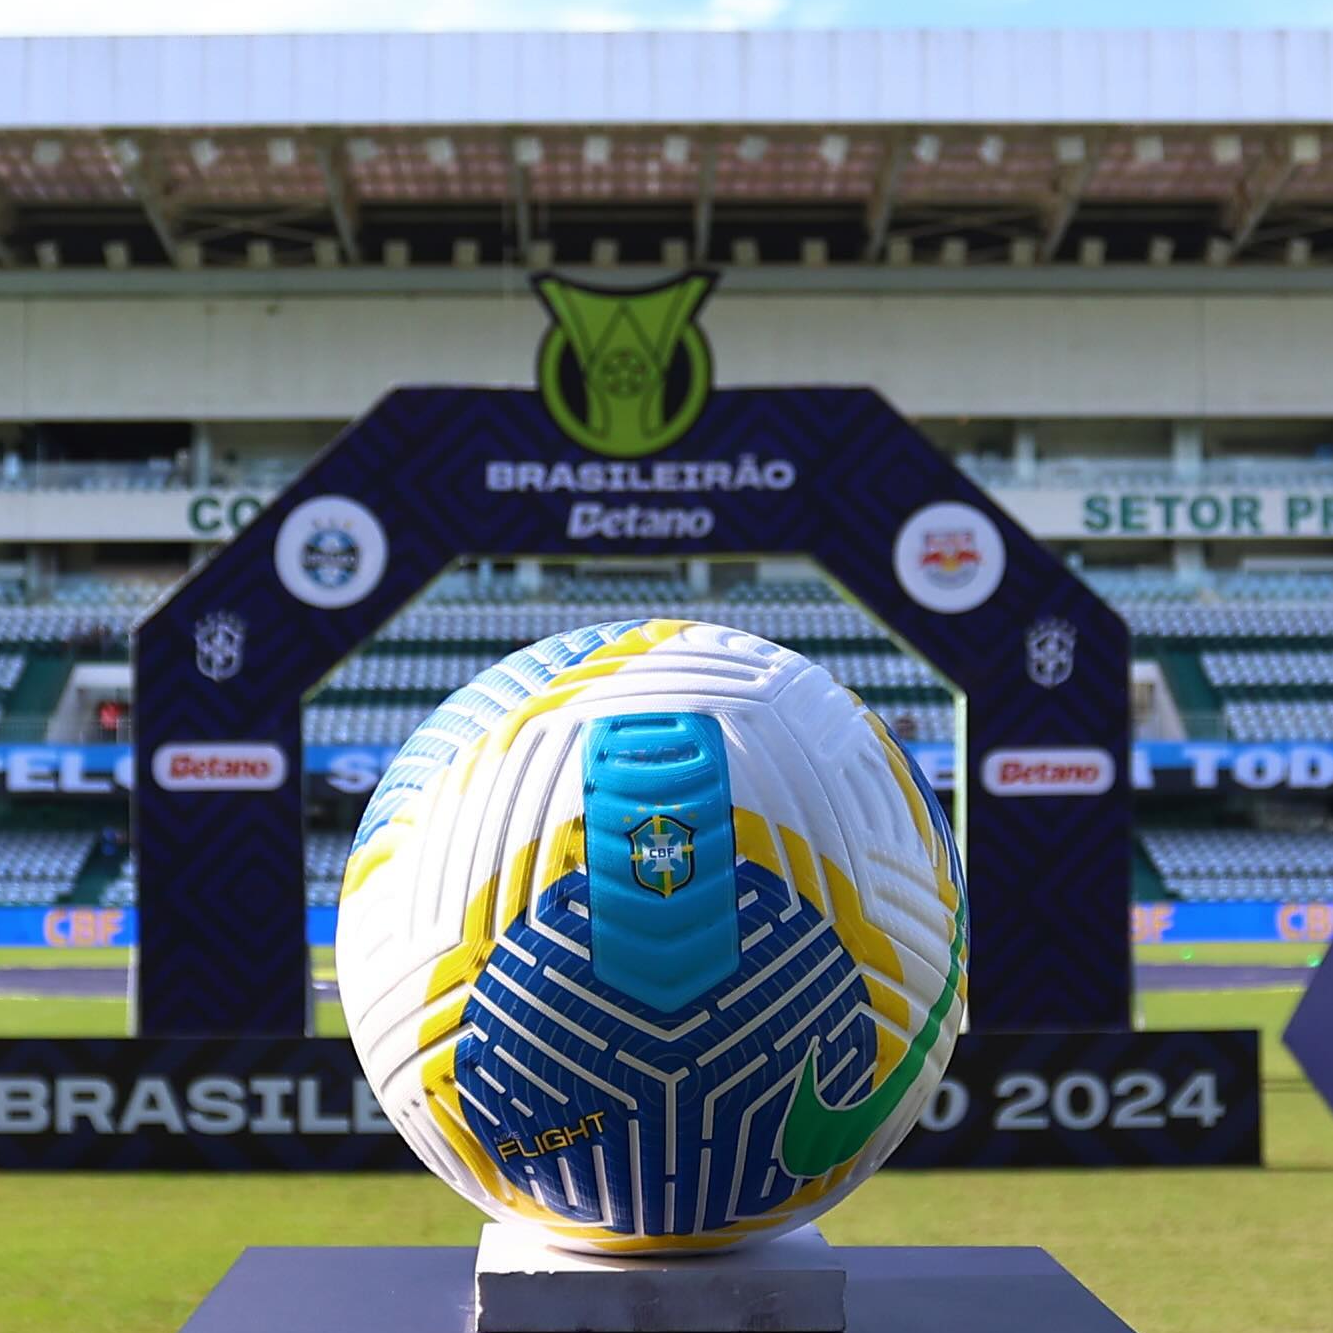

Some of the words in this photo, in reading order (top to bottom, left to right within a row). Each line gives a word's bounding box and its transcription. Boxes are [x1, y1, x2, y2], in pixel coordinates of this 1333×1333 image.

[485, 453, 796, 491] BRASILEIRÃO
[568, 502, 714, 538] Betano
[1083, 494, 1262, 533] SETOR
[170, 753, 271, 779] Betano
[998, 760, 1099, 785] Betano
[648, 847, 675, 859] CBF
[43, 910, 123, 945] CBF
[994, 1071, 1227, 1130] 2024
[497, 1111, 605, 1163] FLIGHT
